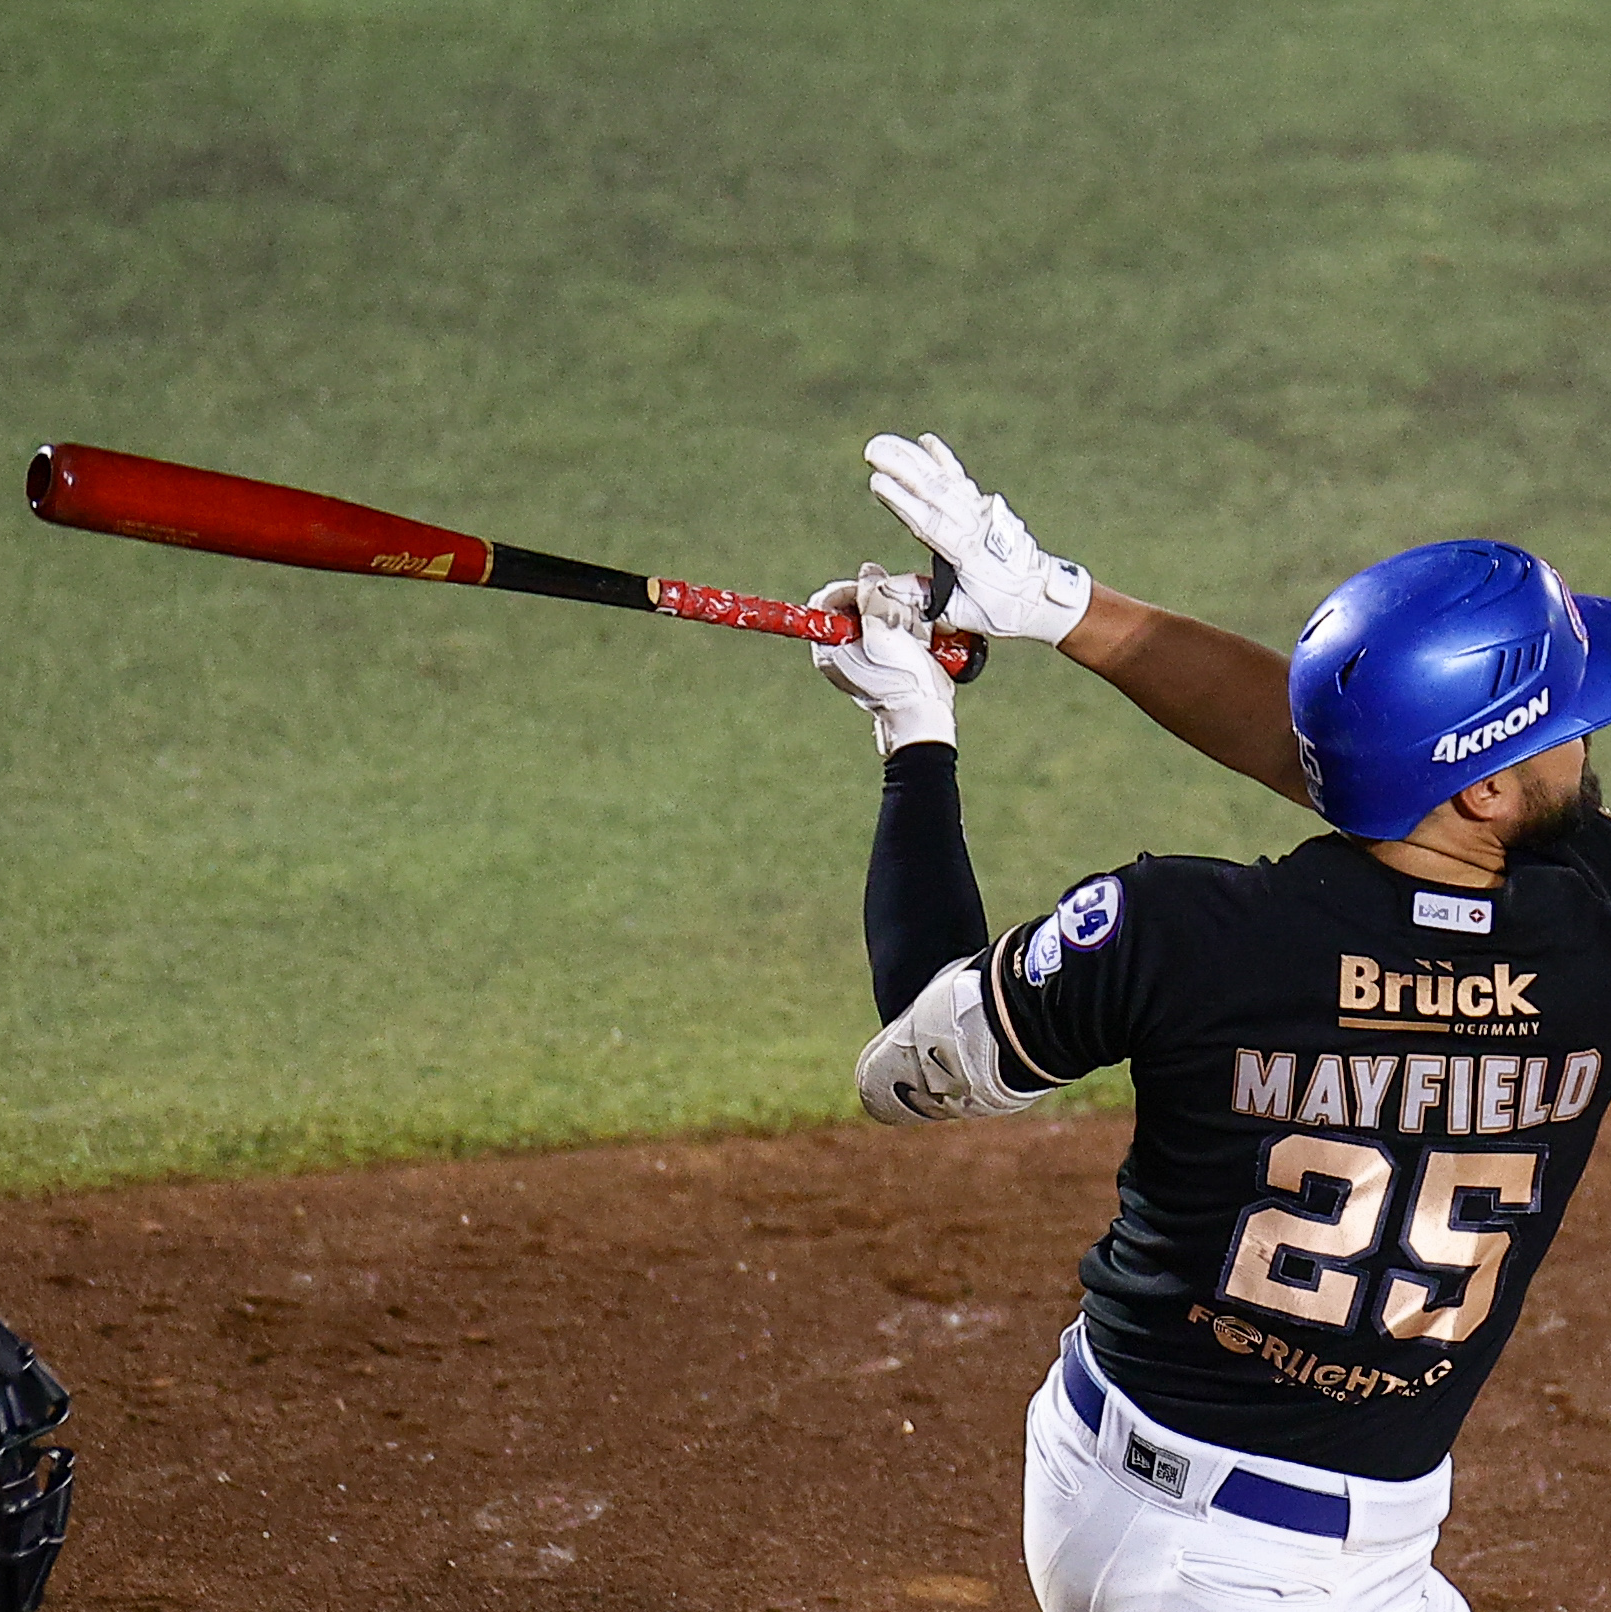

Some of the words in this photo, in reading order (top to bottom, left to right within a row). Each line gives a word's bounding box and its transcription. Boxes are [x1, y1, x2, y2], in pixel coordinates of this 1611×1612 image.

[1431, 687, 1550, 763] AKRON
[1073, 885, 1109, 940] 34
[1338, 953, 1540, 1018] Brück
[1454, 1021, 1540, 1036] GERMANY
[1232, 1048, 1600, 1134] MAYFIELD
[1220, 1132, 1549, 1345] 25
[1187, 1303, 1454, 1400] FORLIGHTG
[1155, 1470, 1177, 1485] ERA
[1157, 1460, 1179, 1476] NEW
